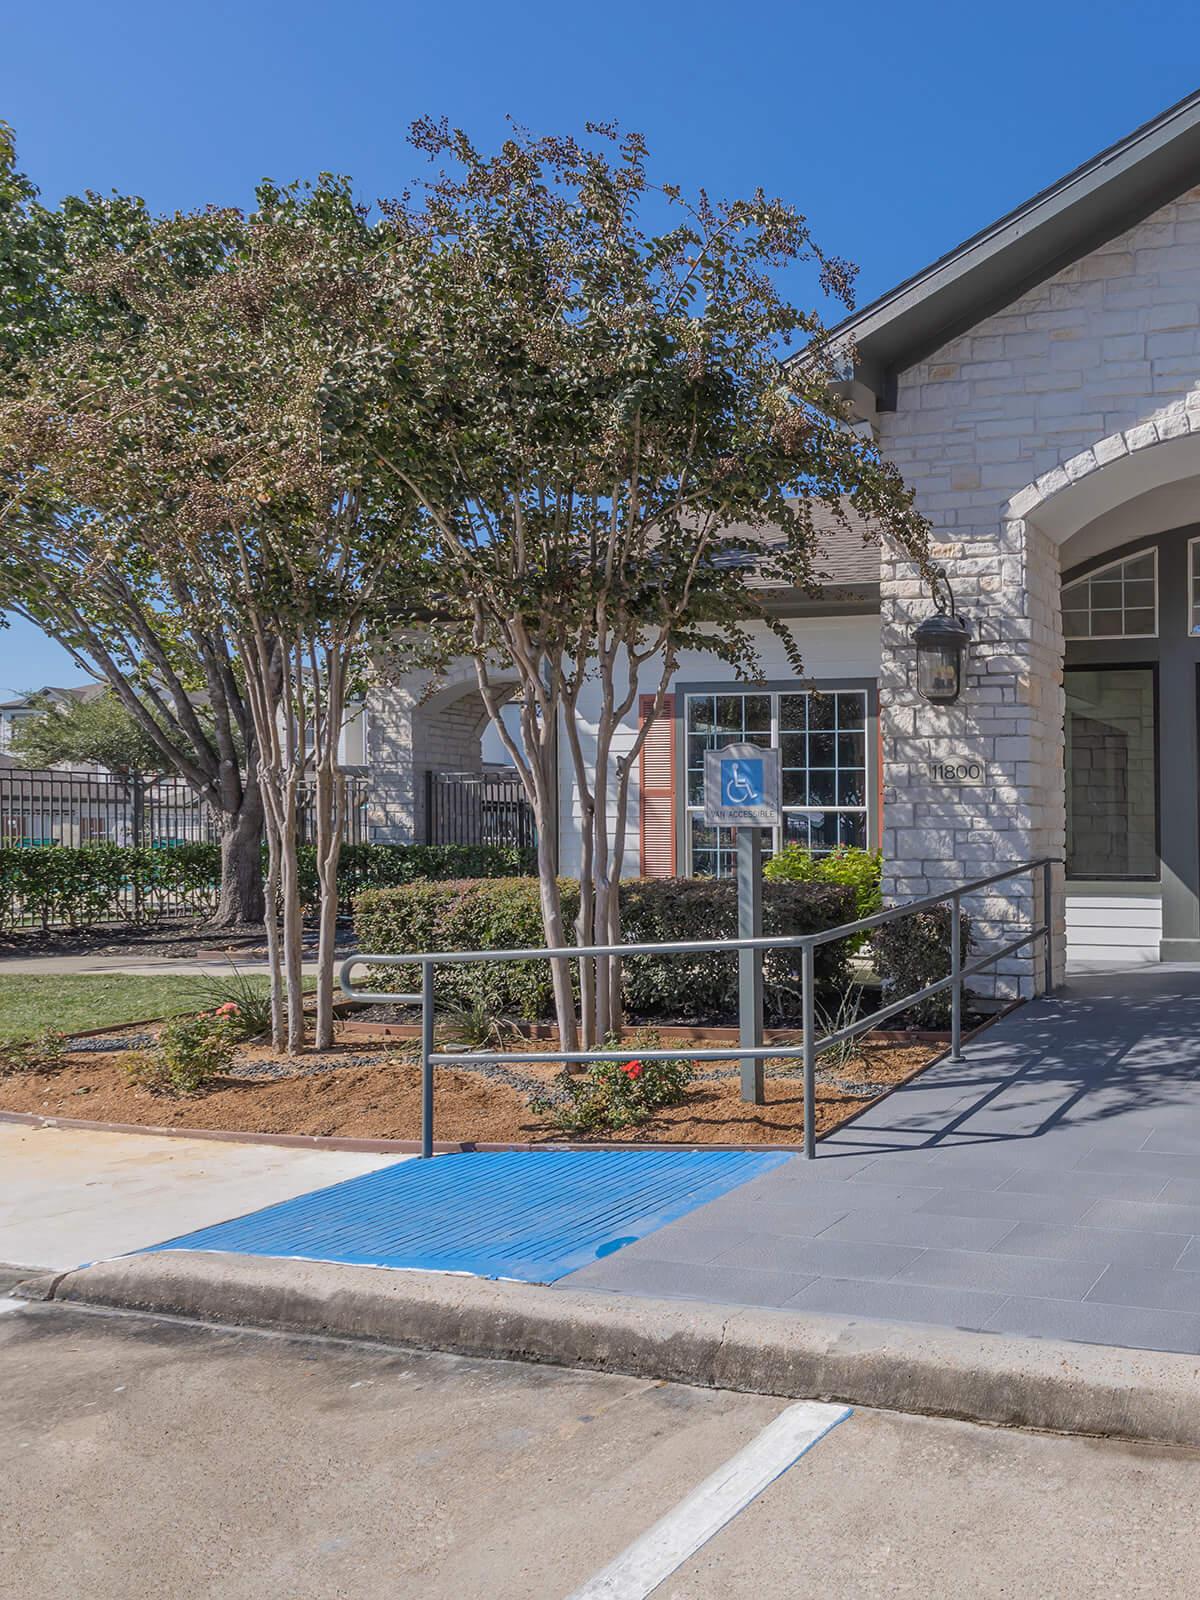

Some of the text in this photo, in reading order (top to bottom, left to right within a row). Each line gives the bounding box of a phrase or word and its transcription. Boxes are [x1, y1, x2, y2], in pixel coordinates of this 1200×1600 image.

[931, 764, 980, 780] 11800
[710, 810, 776, 818] VAN ACCESSIBLE
